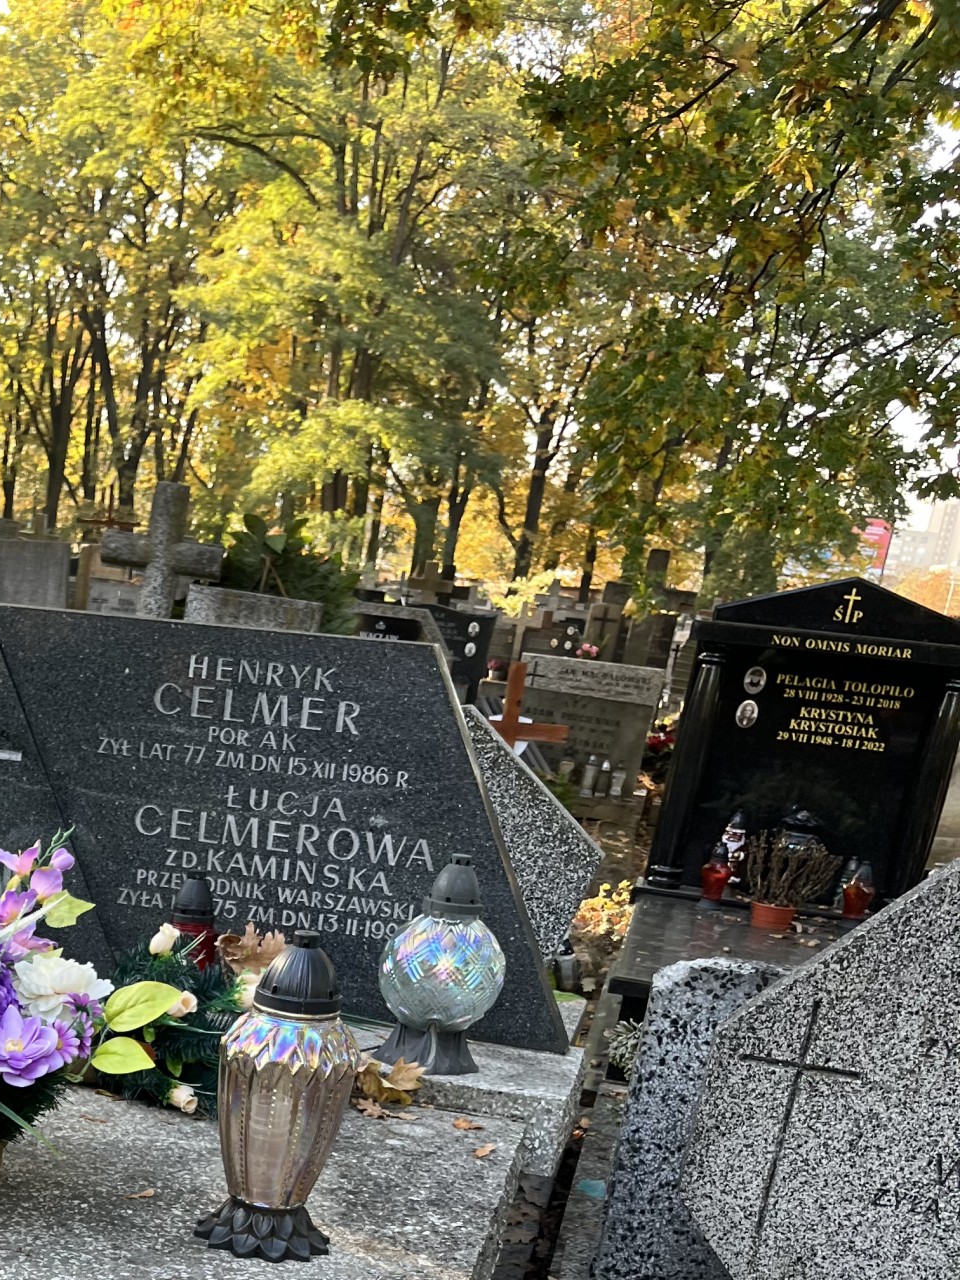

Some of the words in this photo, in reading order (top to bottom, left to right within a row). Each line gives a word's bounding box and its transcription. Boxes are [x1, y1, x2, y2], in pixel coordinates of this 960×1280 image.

[771, 634, 801, 647] NON
[805, 638, 851, 653] OMNIS
[855, 643, 912, 659] MORIAR
[188, 654, 337, 692] HENRYK
[776, 673, 837, 690] PELAGIA
[153, 682, 360, 735] CELMER
[783, 688, 796, 698] 28
[798, 690, 819, 701] VIII
[821, 692, 844, 703] 1928
[877, 698, 901, 710] 2018
[799, 706, 874, 725] KRYSTYNA
[208, 726, 252, 747] POR
[789, 718, 880, 739] KRYSTOSIAK
[776, 731, 790, 740] 29
[791, 732, 808, 743] VII
[810, 735, 833, 746] 1948
[841, 738, 853, 748] 18
[861, 740, 886, 752] 2022
[139, 741, 177, 760] LAT
[183, 744, 206, 765] 77
[342, 763, 390, 785] 1986
[224, 785, 347, 822] ŁUCJA
[135, 805, 435, 872] CELMEROWA
[277, 886, 415, 921] WARSZAWSKI
